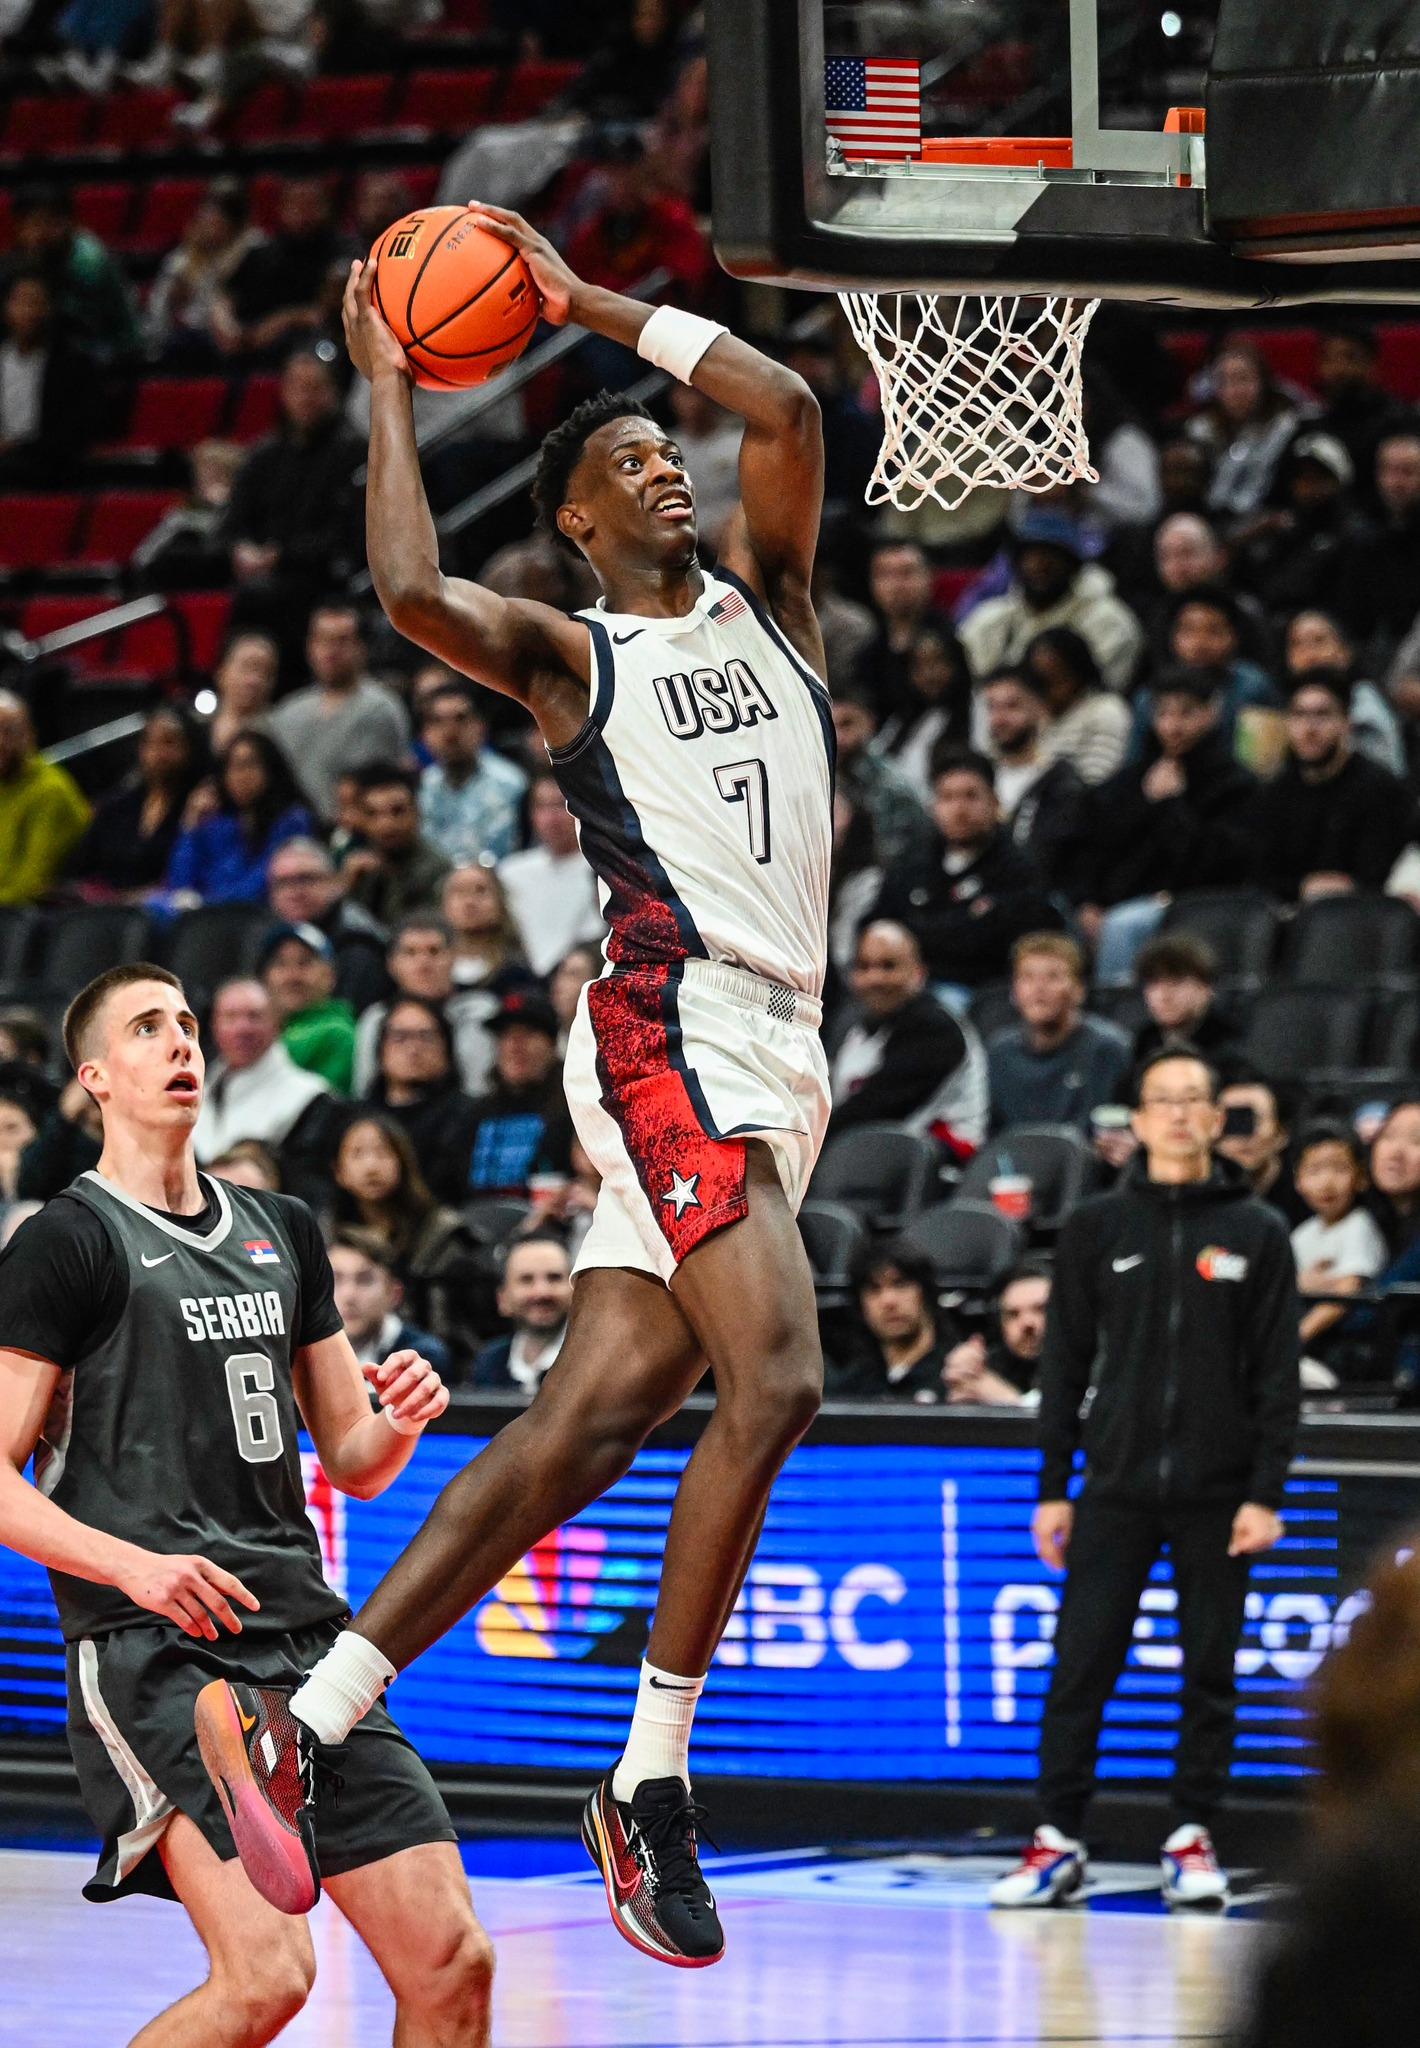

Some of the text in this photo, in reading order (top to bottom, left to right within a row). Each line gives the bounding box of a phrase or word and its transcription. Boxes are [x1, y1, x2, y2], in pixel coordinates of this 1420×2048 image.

[653, 659, 778, 740] USA
[713, 758, 771, 865] 7
[180, 1291, 285, 1341] SERBIA
[224, 1353, 284, 1463] 6
